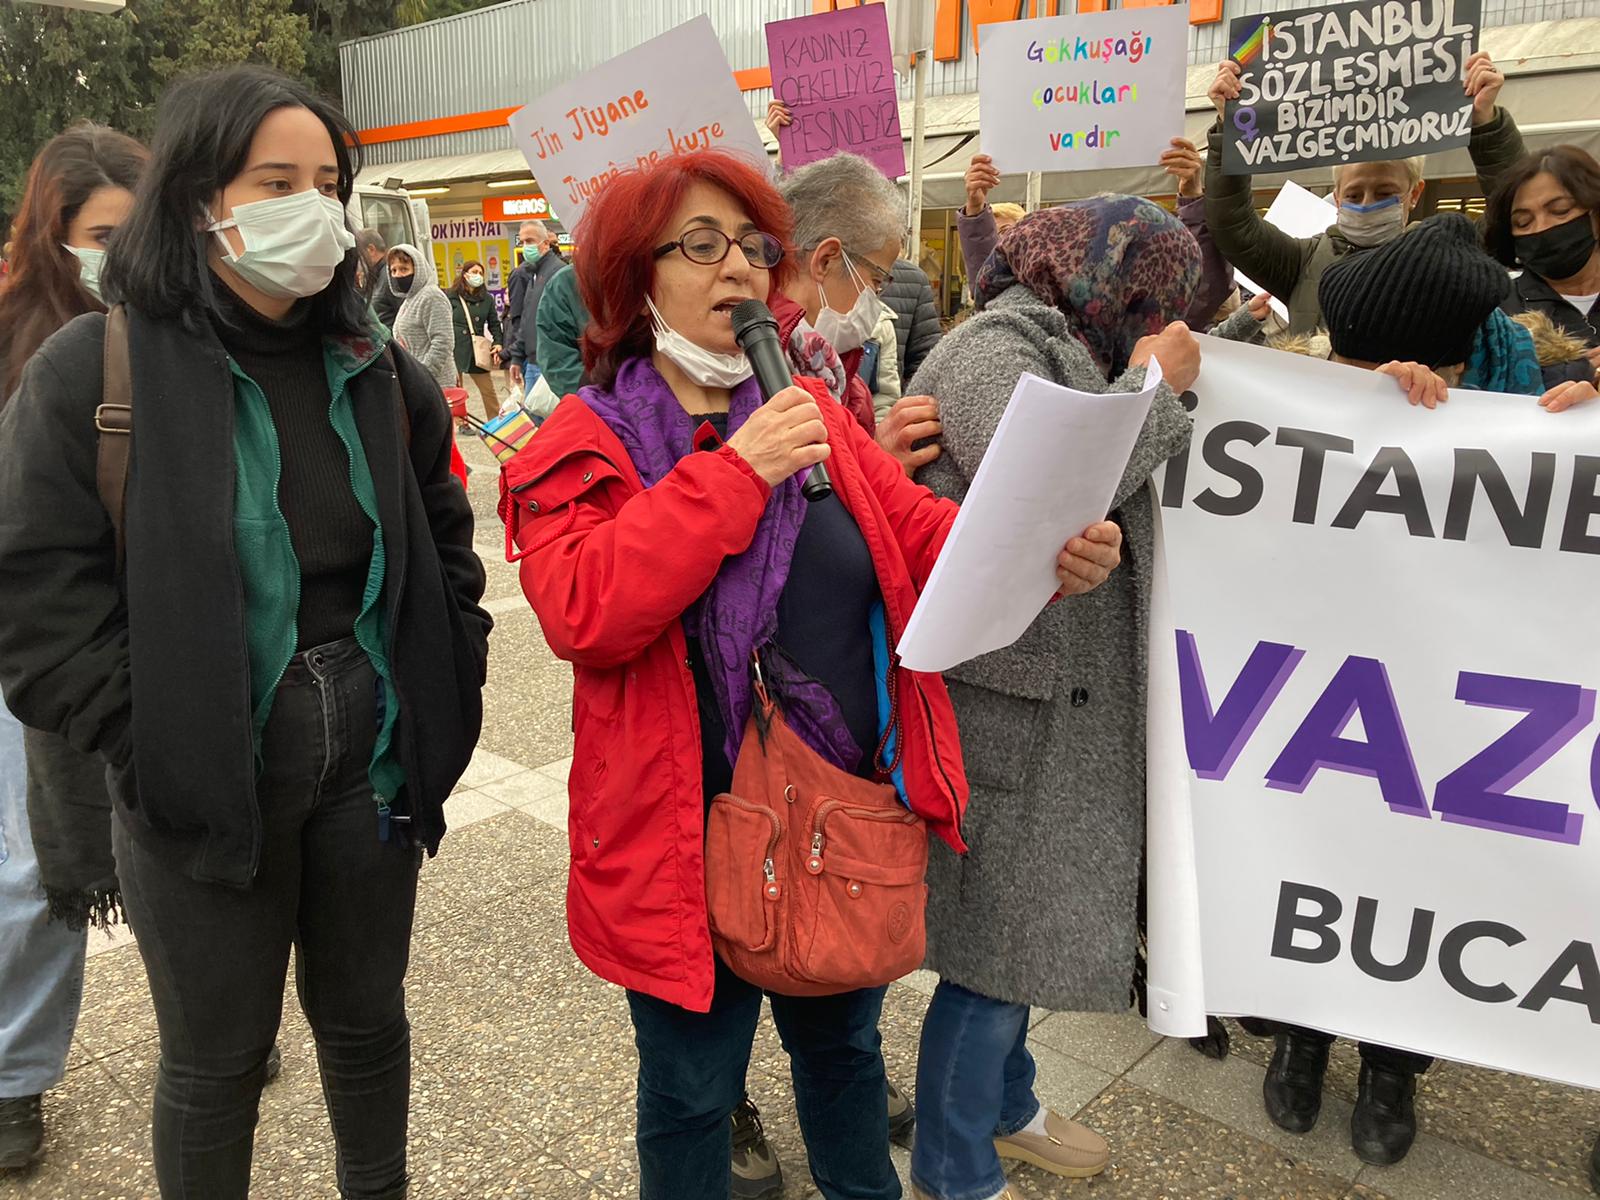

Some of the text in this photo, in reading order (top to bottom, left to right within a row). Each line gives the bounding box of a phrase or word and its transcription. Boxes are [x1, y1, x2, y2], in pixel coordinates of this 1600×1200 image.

[781, 28, 872, 69] KADINIZ
[1027, 30, 1152, 64] Gökkuşağı
[1262, 0, 1473, 61] İSTANBUL
[1031, 80, 1137, 111] çocukları
[1277, 86, 1409, 132] BİZİMDİR
[1049, 124, 1121, 152] vardır
[1235, 104, 1474, 165] VAZGEÇMİYORUZ
[432, 224, 447, 239] OK
[450, 219, 466, 238] İYİ
[1174, 628, 1600, 846] VAZ
[1270, 880, 1600, 1025] BUCA
